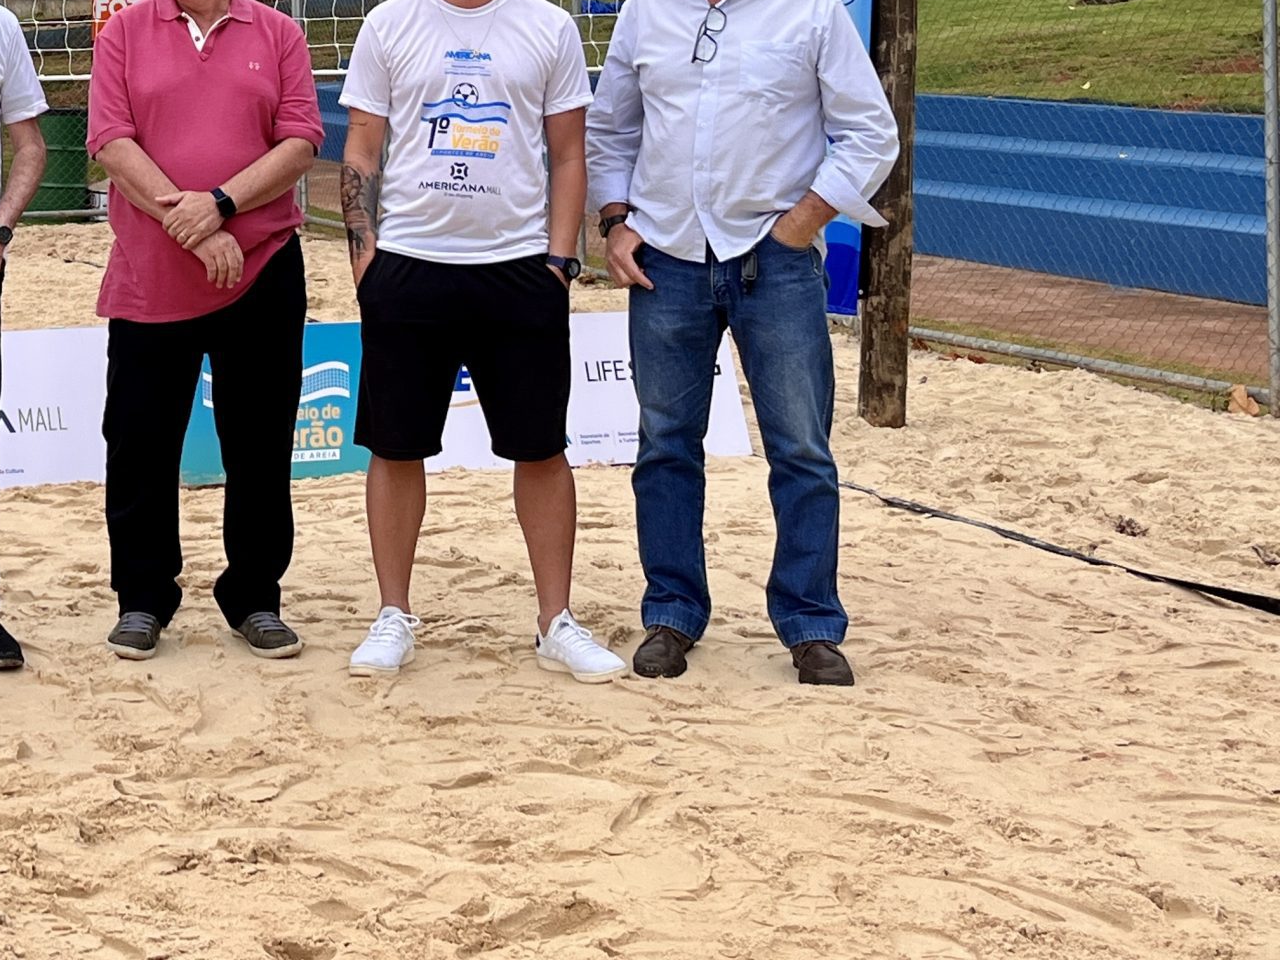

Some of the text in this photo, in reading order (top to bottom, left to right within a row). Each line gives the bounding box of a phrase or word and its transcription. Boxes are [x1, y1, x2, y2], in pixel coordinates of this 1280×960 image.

[451, 134, 499, 152] Verão
[418, 181, 486, 194] AMERICANA
[584, 360, 627, 382] LIFE
[18, 406, 68, 432] MALL
[322, 403, 341, 419] de
[293, 451, 337, 460] DE AREIA
